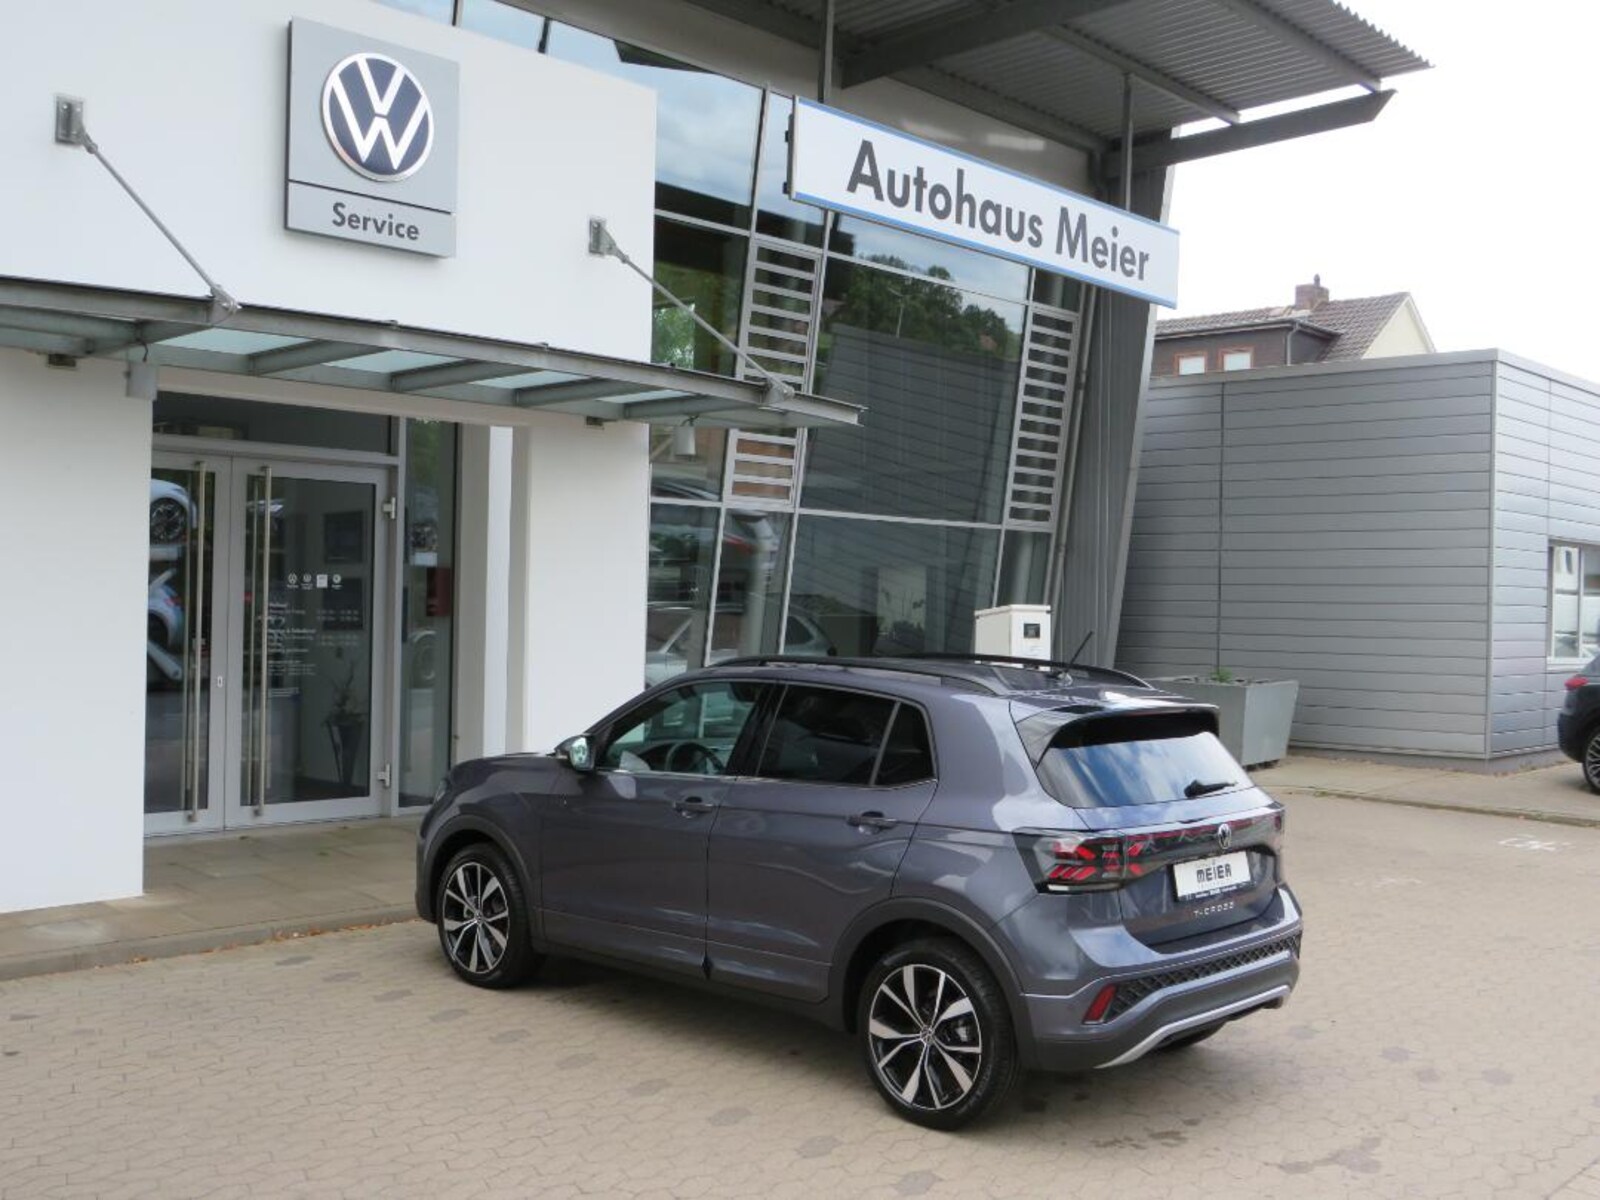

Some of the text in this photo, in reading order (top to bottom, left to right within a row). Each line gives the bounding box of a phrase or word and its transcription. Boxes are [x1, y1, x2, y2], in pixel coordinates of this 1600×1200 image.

[322, 53, 433, 181] VW
[332, 202, 420, 240] Service
[846, 139, 1150, 280] Autohaus Meier
[1196, 863, 1232, 883] MEIER
